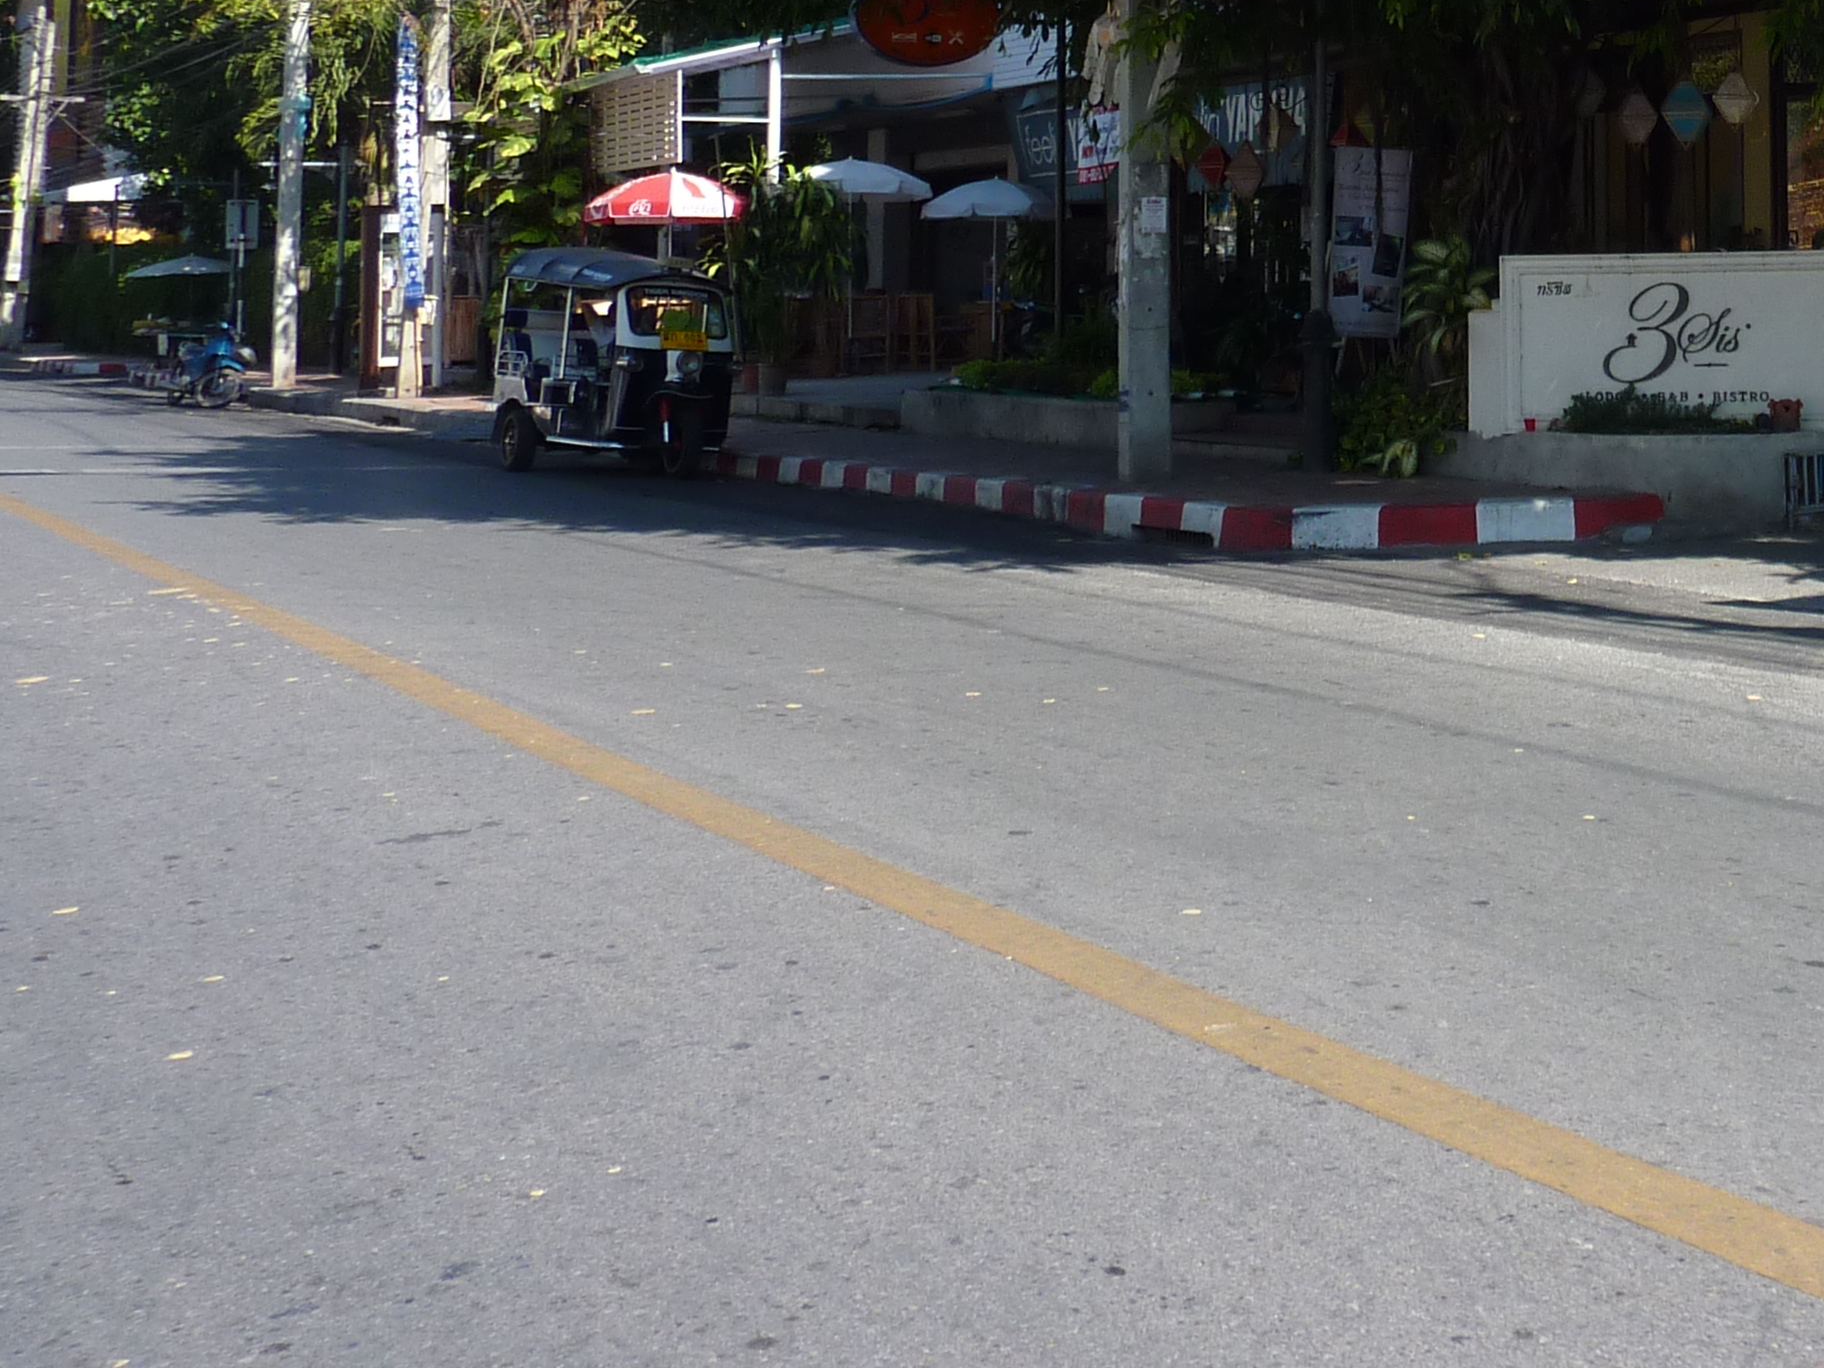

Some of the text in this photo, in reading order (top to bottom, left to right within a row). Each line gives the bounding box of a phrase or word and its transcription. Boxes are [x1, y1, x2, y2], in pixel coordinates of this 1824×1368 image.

[1603, 282, 1689, 384] 3
[1585, 391, 1632, 403] LODG
[1713, 390, 1770, 403] BISTRO
